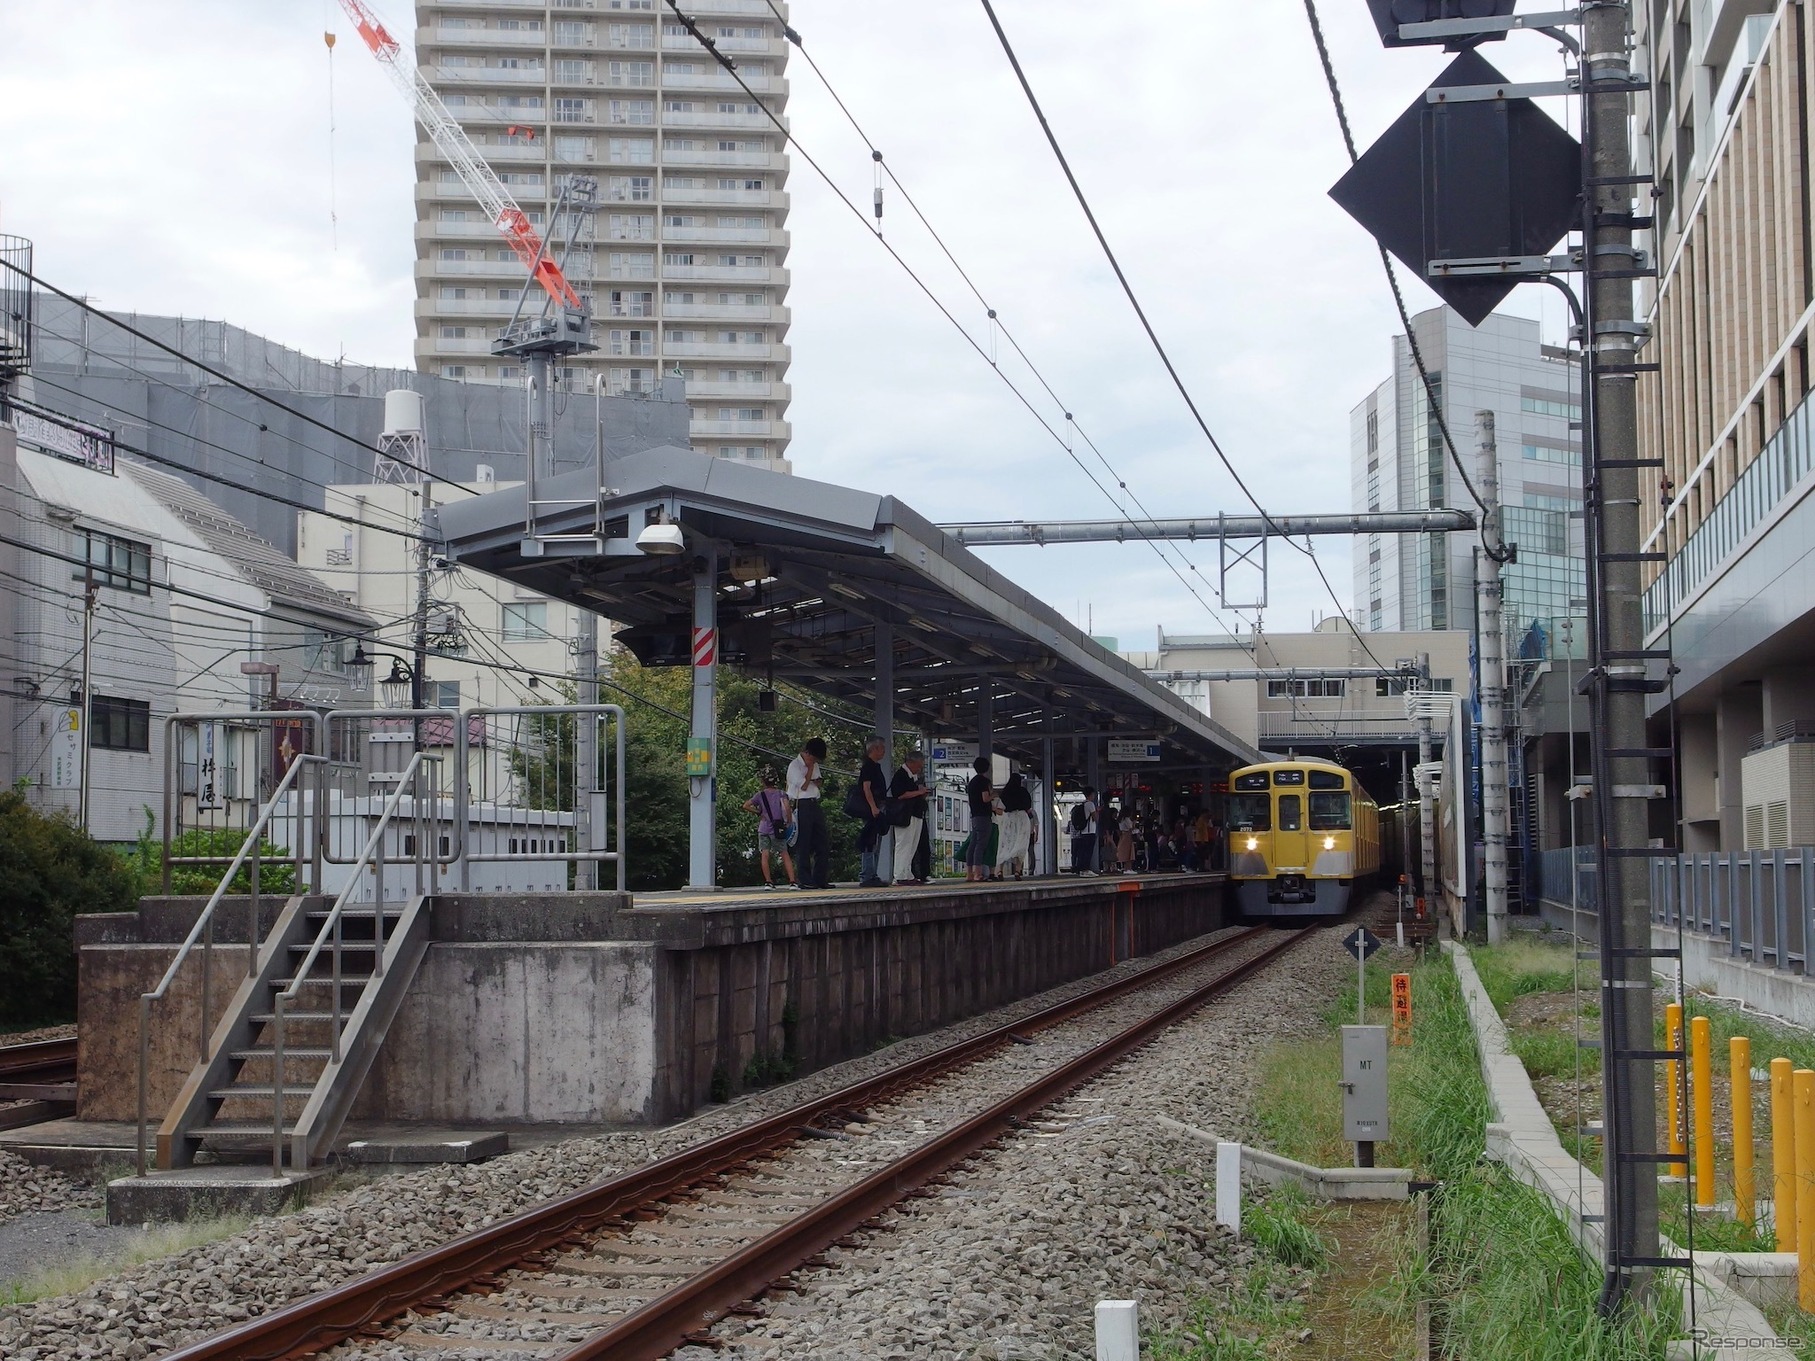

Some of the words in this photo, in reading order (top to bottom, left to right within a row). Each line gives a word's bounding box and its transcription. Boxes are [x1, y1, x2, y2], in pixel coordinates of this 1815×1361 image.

[66, 734, 77, 785] セサミクラブ
[940, 750, 945, 758] 2
[1359, 1060, 1373, 1071] MT
